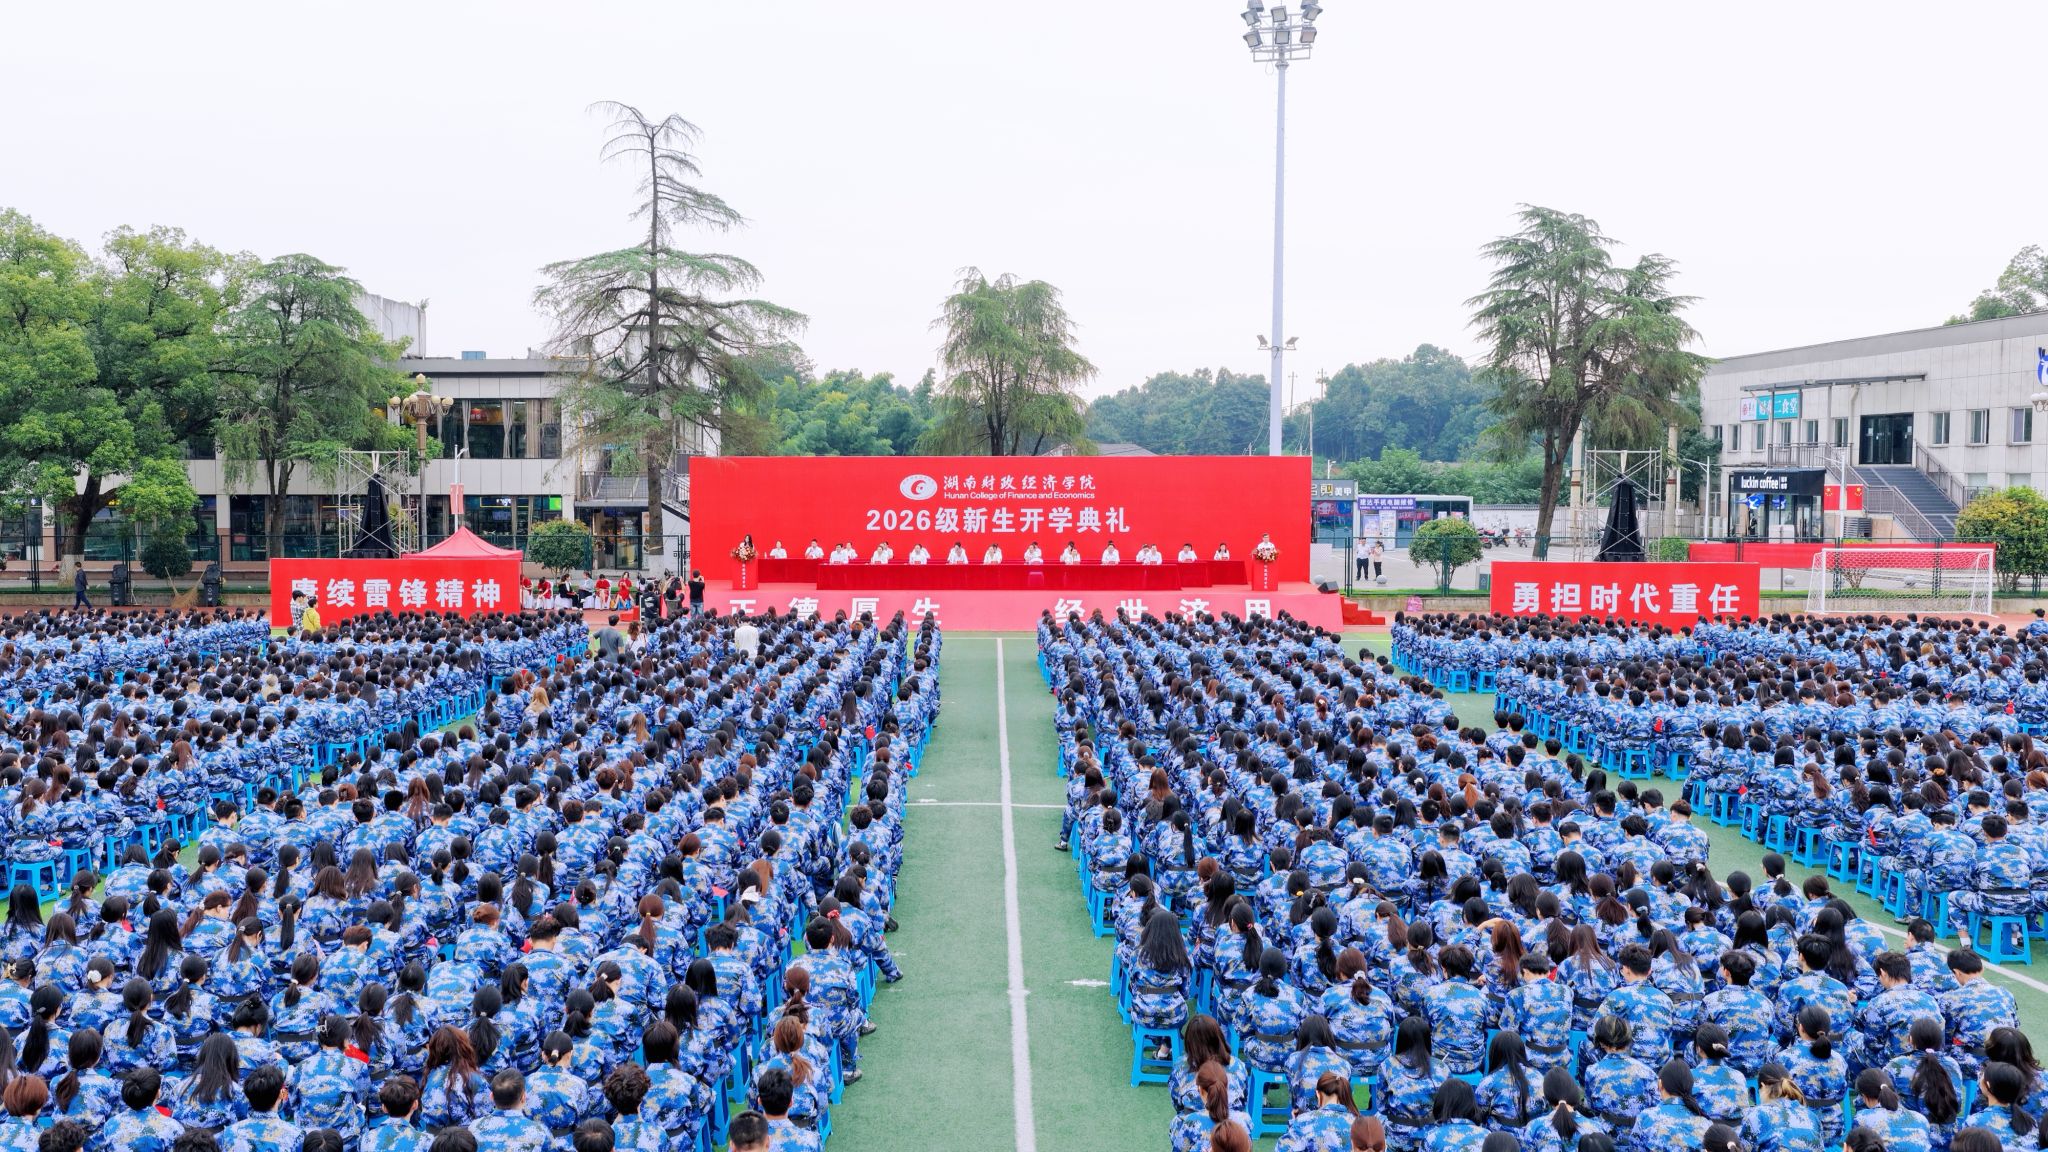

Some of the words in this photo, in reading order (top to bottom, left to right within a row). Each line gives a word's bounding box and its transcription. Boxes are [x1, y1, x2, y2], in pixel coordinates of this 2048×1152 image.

[943, 475, 1096, 491] 湖南财政经济学院
[1741, 476, 1758, 489] luckin
[1760, 476, 1778, 489] coffee
[970, 492, 998, 500] College
[866, 507, 1130, 533] 2026级新生开学典礼
[1513, 582, 1740, 613] 勇担时代重任
